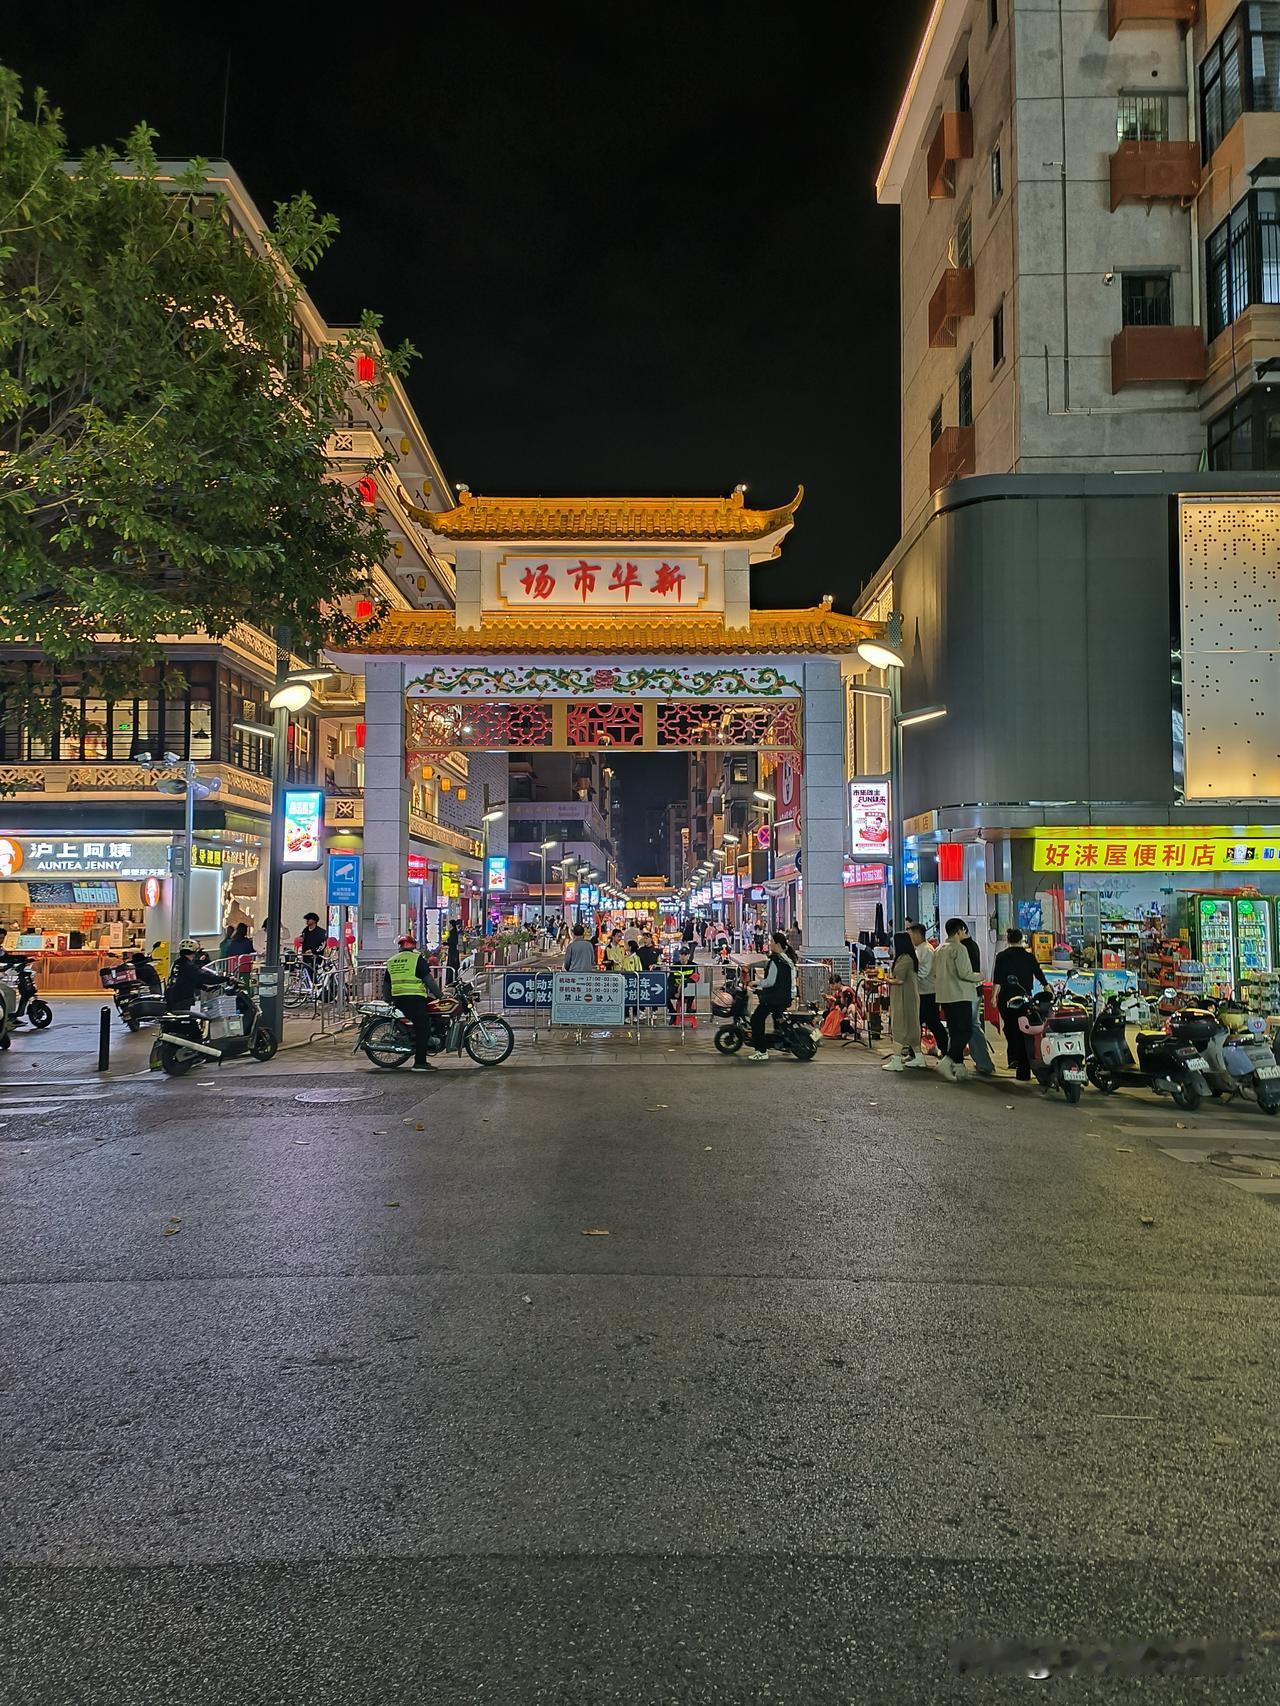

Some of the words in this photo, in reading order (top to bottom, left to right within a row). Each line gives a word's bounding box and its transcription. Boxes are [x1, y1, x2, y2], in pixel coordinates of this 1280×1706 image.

[28, 842, 133, 859] 沪上阿姨
[1044, 843, 1216, 867] 好涞屋便利店
[37, 860, 83, 871] AUNTEA
[84, 860, 122, 871] JENNY
[559, 977, 577, 985] 机动车
[564, 994, 582, 1003] 禁止
[596, 994, 614, 1003] 驶入
